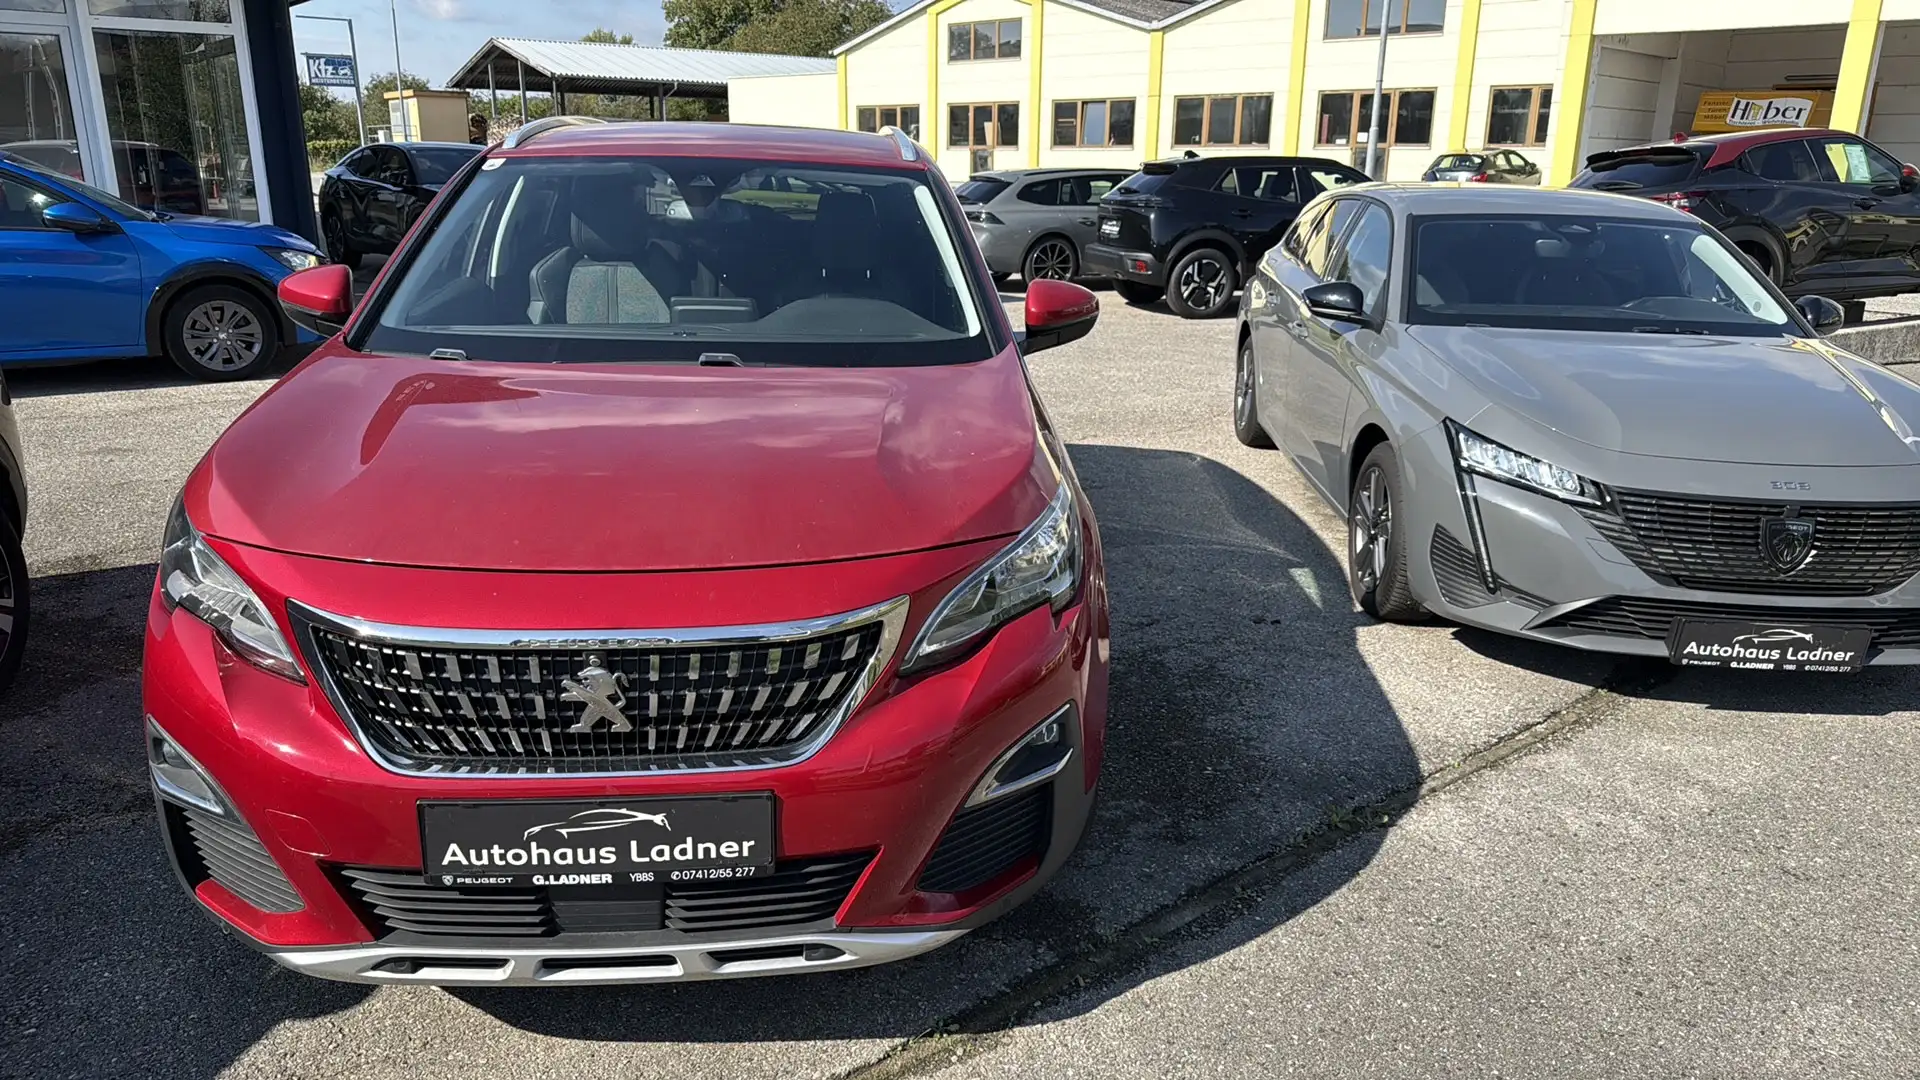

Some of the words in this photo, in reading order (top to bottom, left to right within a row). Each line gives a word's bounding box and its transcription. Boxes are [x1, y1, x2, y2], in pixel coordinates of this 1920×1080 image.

[309, 58, 335, 77] Kfz
[1683, 641, 1781, 660] Autohaus
[1786, 648, 1855, 662] Ladner
[1730, 661, 1774, 670] G.LADNER
[442, 841, 617, 866] Autohaus
[630, 836, 755, 864] Ladner
[532, 873, 613, 886] G.LADNER
[629, 872, 655, 882] YBBS
[682, 868, 733, 880] 07412/55
[735, 867, 756, 877] 277
